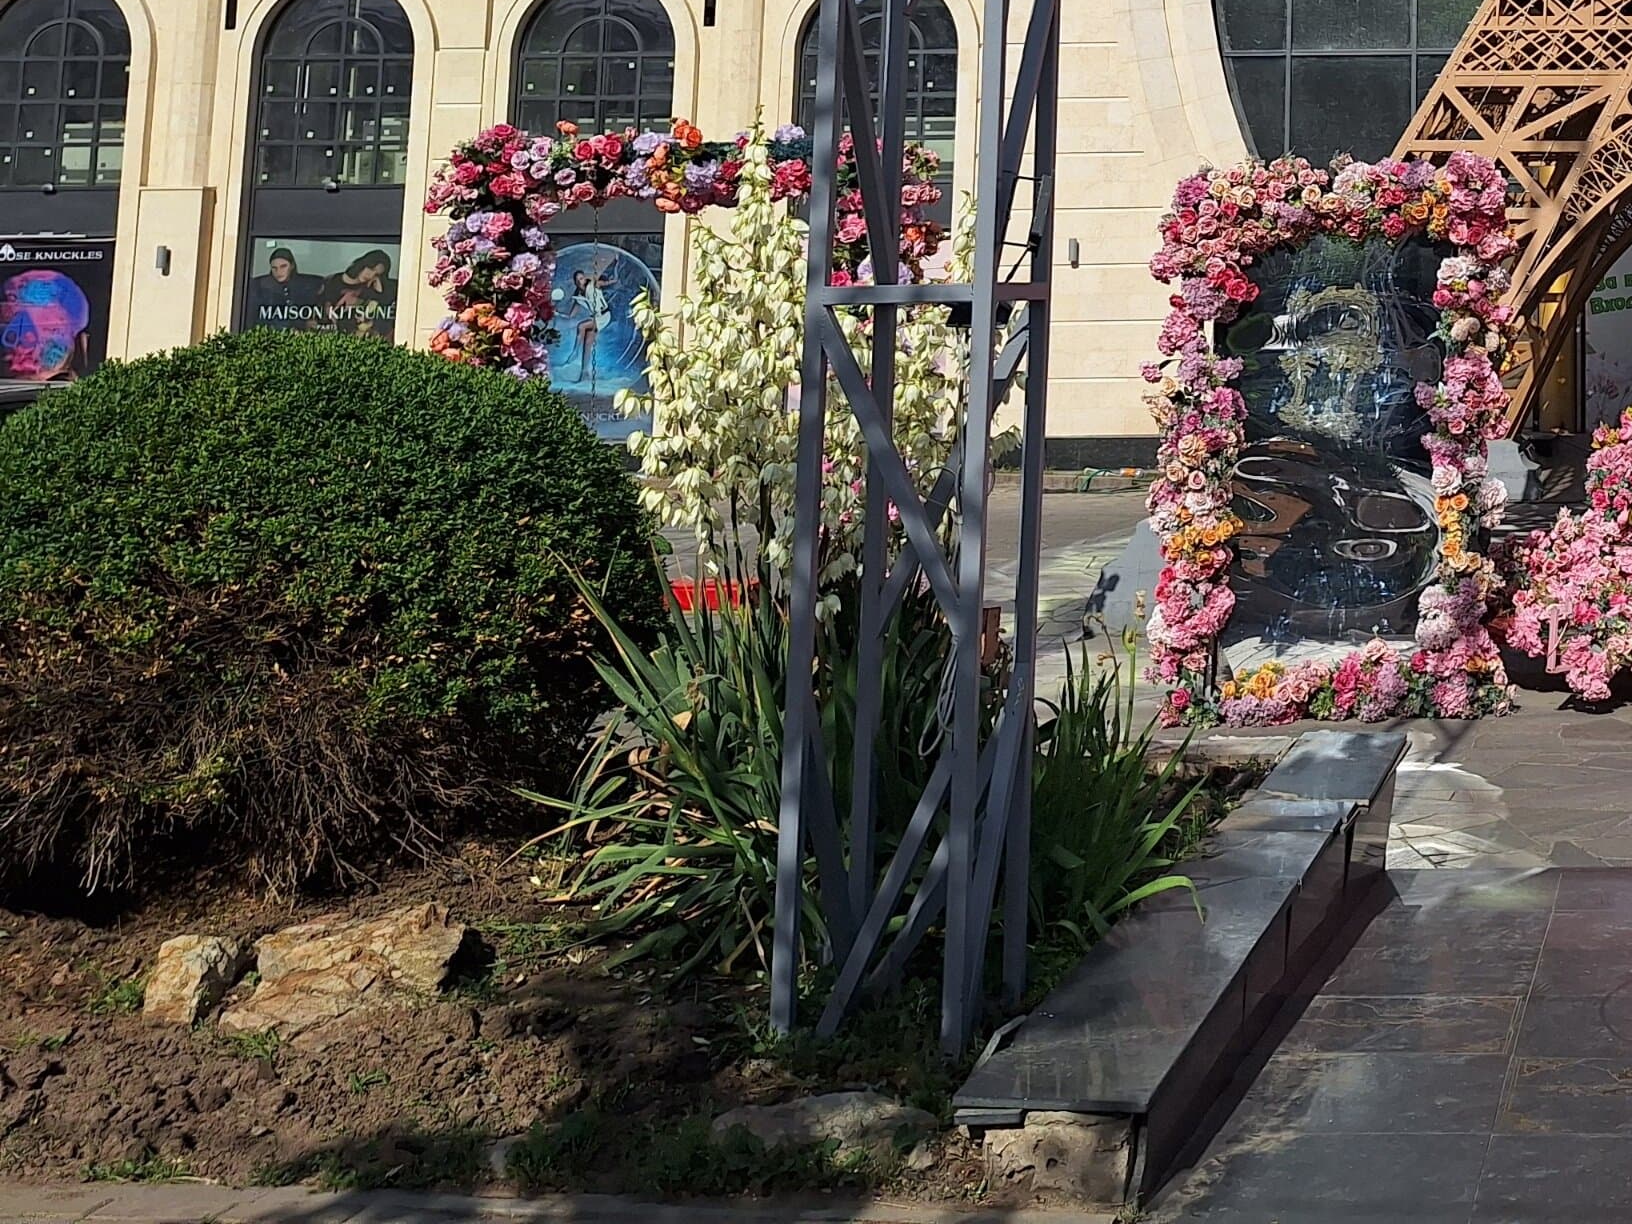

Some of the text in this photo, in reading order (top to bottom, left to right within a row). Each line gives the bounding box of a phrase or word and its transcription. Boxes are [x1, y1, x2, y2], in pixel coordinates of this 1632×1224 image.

[35, 250, 103, 261] KNUCKLES
[259, 301, 396, 320] MAISON KITSUNÉ
